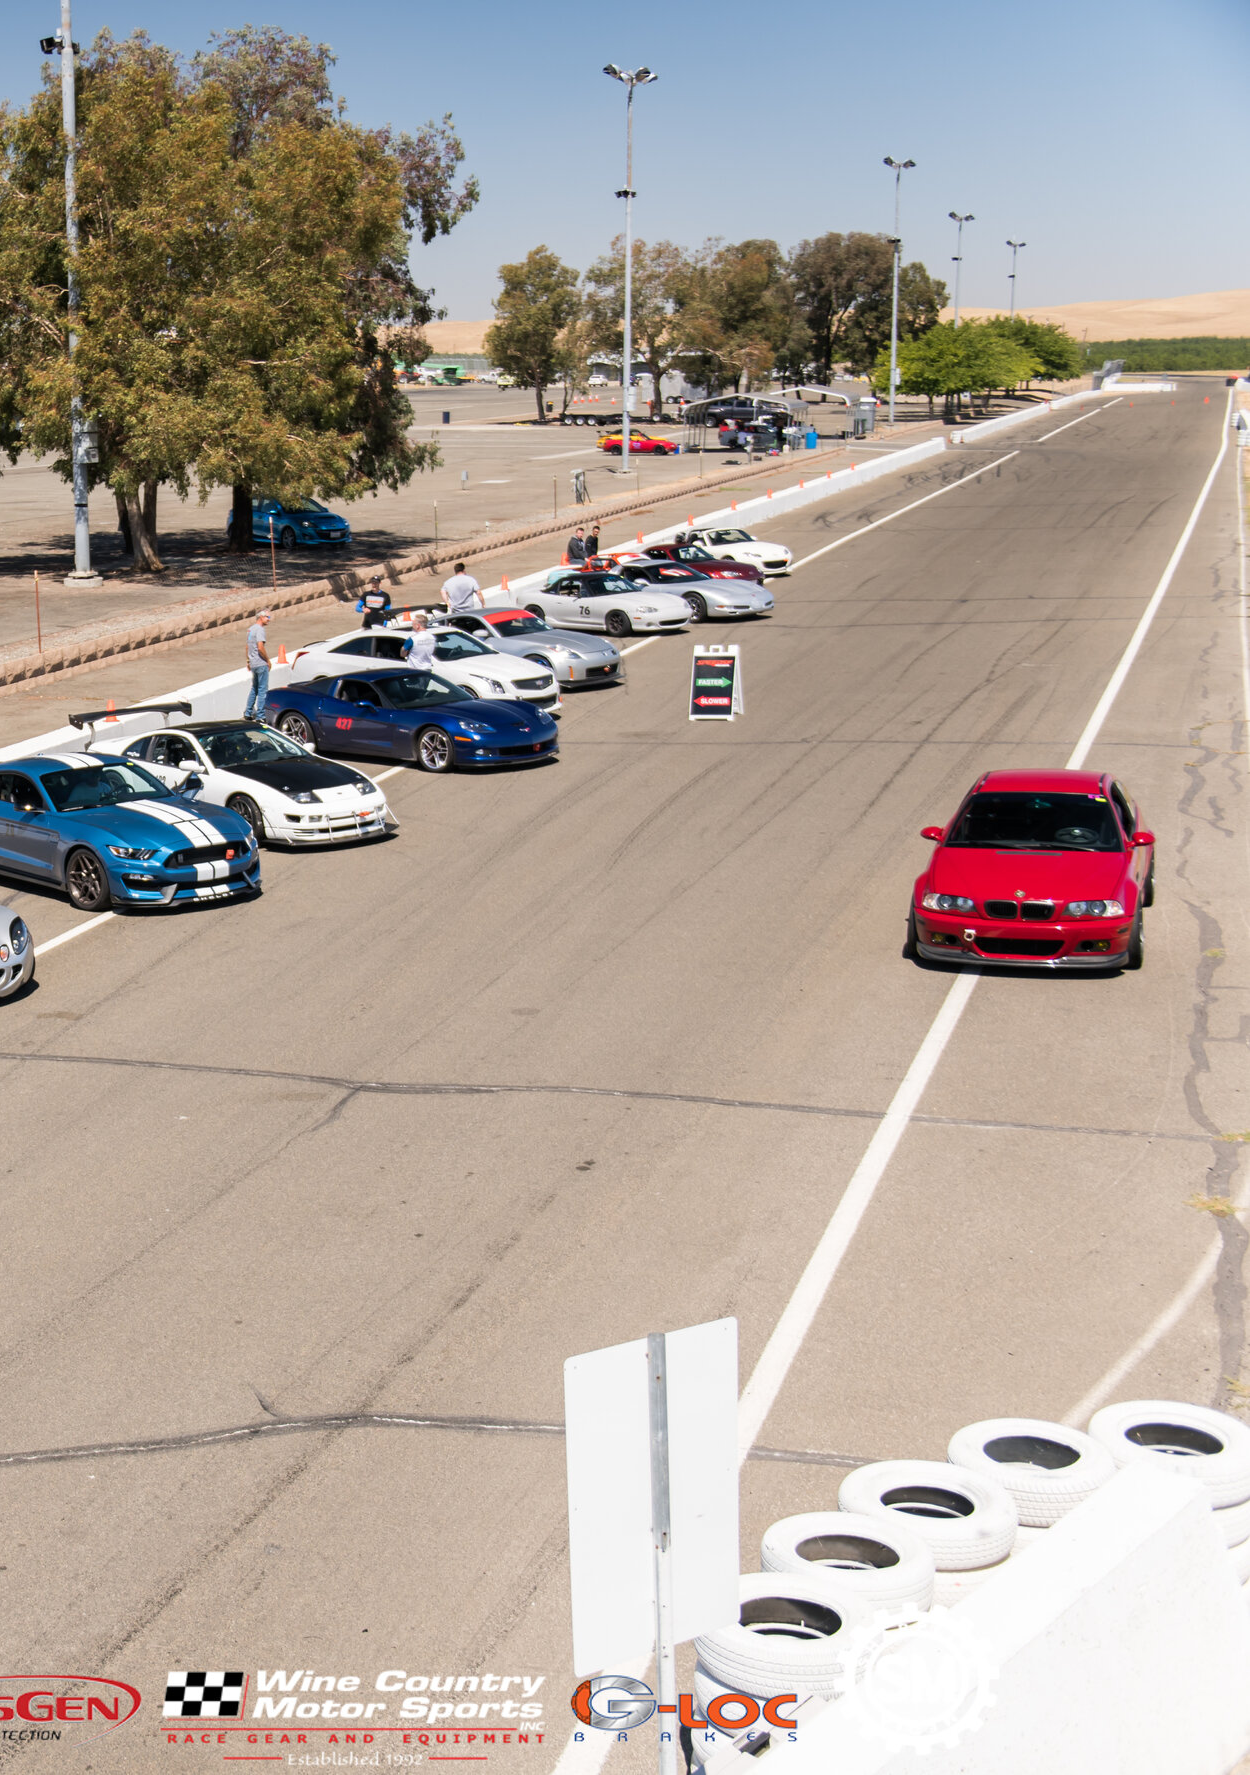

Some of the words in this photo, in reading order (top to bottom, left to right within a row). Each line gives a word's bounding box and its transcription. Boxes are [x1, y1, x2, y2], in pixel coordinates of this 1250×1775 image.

[579, 606, 591, 615] 76
[700, 697, 728, 705] SLOWER
[335, 717, 353, 731] 427
[193, 891, 234, 902] SHELBY
